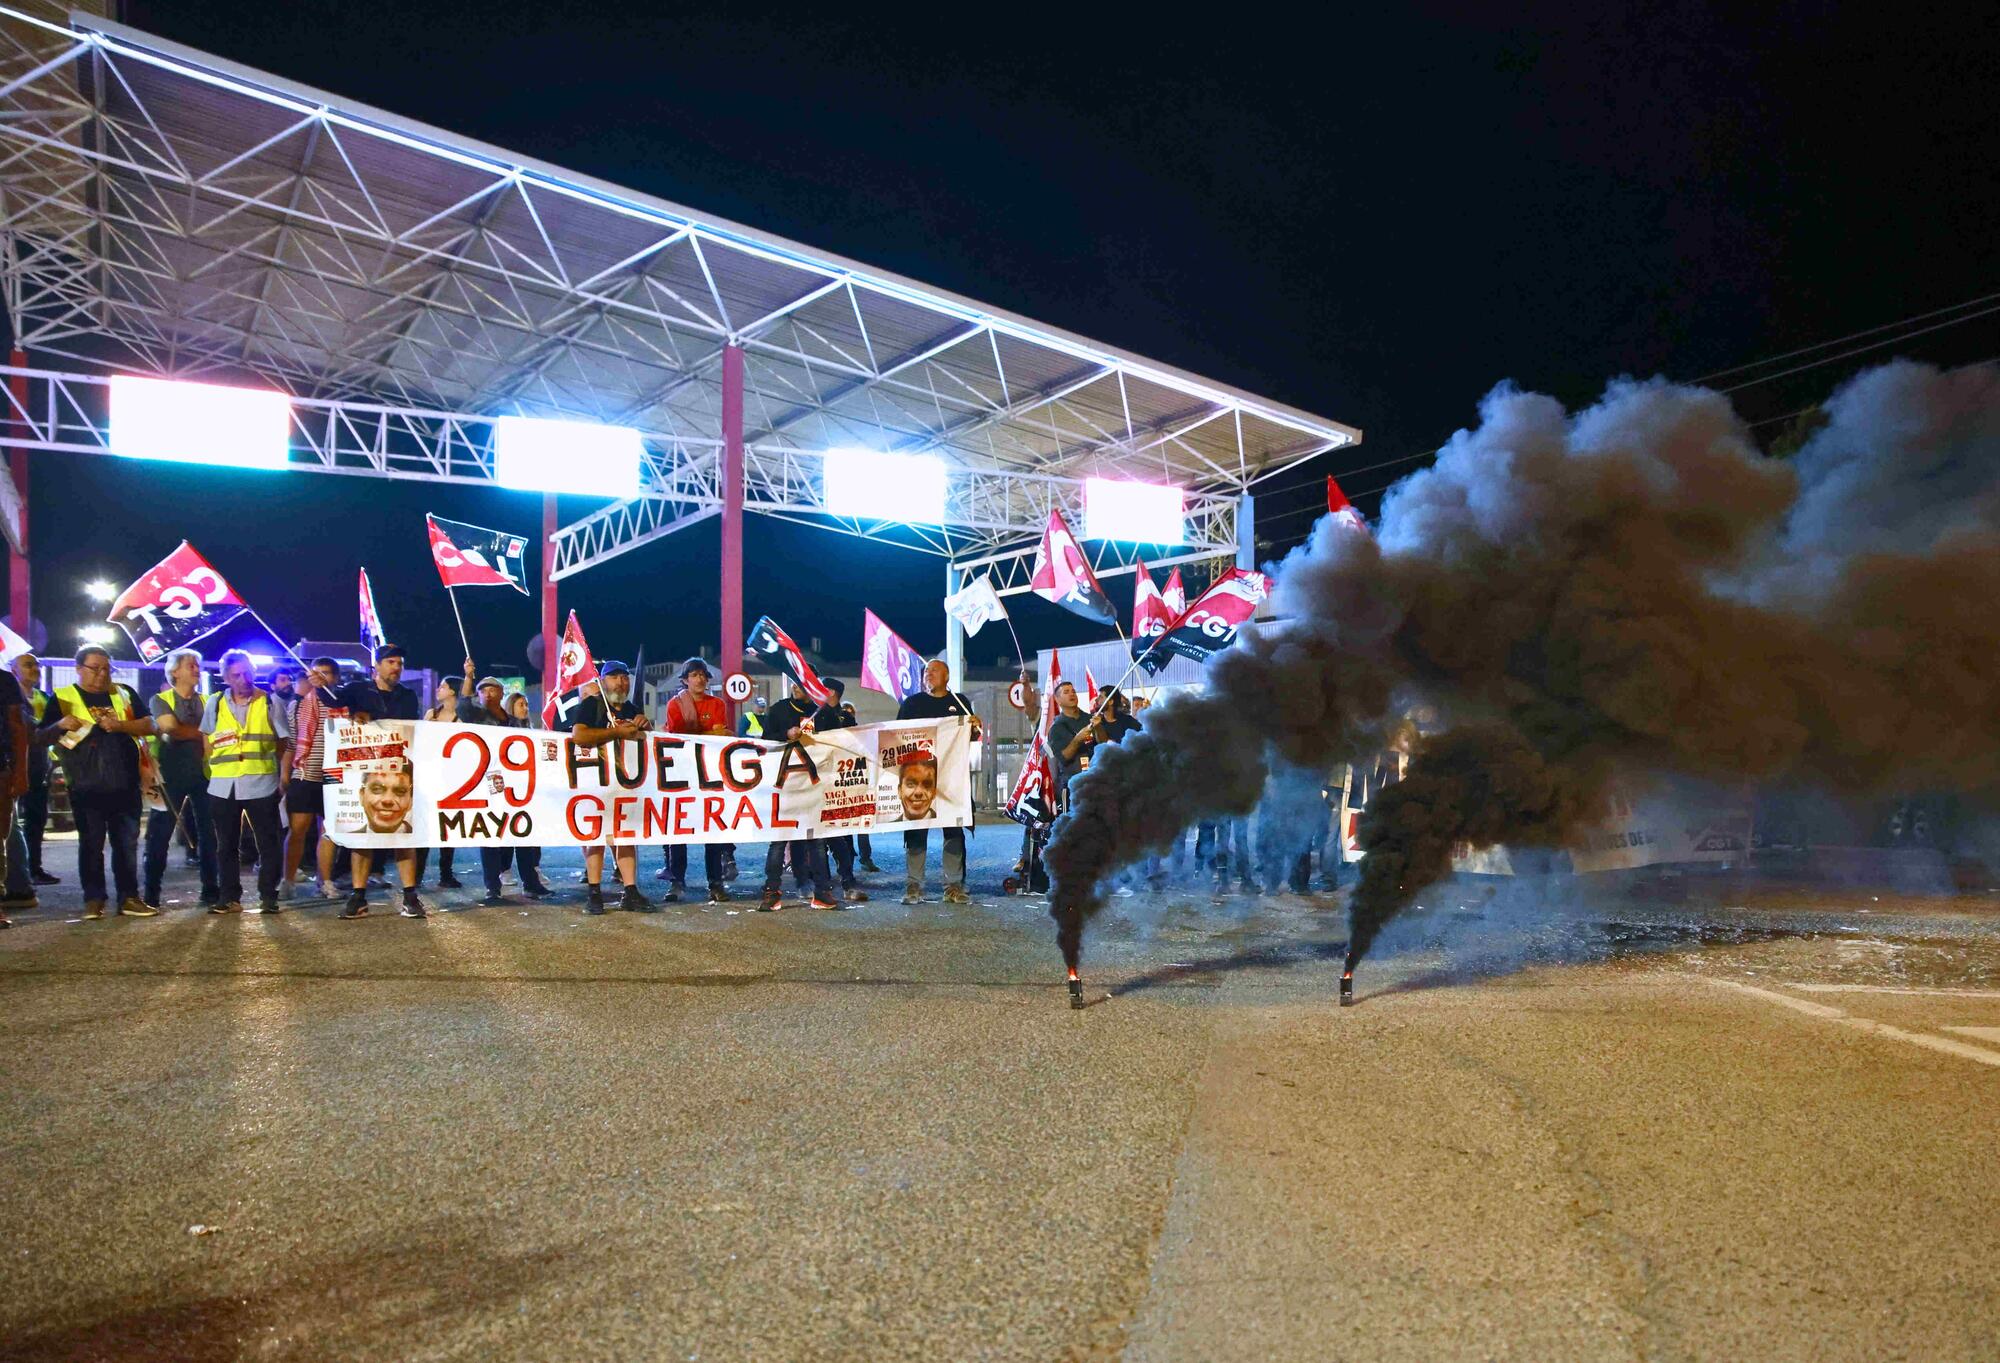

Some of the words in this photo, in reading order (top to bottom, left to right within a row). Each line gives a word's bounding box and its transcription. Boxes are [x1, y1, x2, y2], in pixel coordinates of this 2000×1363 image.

[1138, 616, 1166, 637] CG
[730, 680, 747, 693] 10
[882, 747, 895, 761] 29
[896, 742, 919, 756] VAGA
[437, 731, 537, 809] 29
[564, 737, 821, 793] HUELGA
[837, 757, 867, 773] 29M
[834, 778, 869, 788] GENERAL
[839, 770, 864, 781] VAGA
[825, 790, 846, 800] VAGA
[836, 794, 876, 806] GENERAL
[438, 810, 533, 842] MAYO
[564, 793, 800, 842] GENERAL
